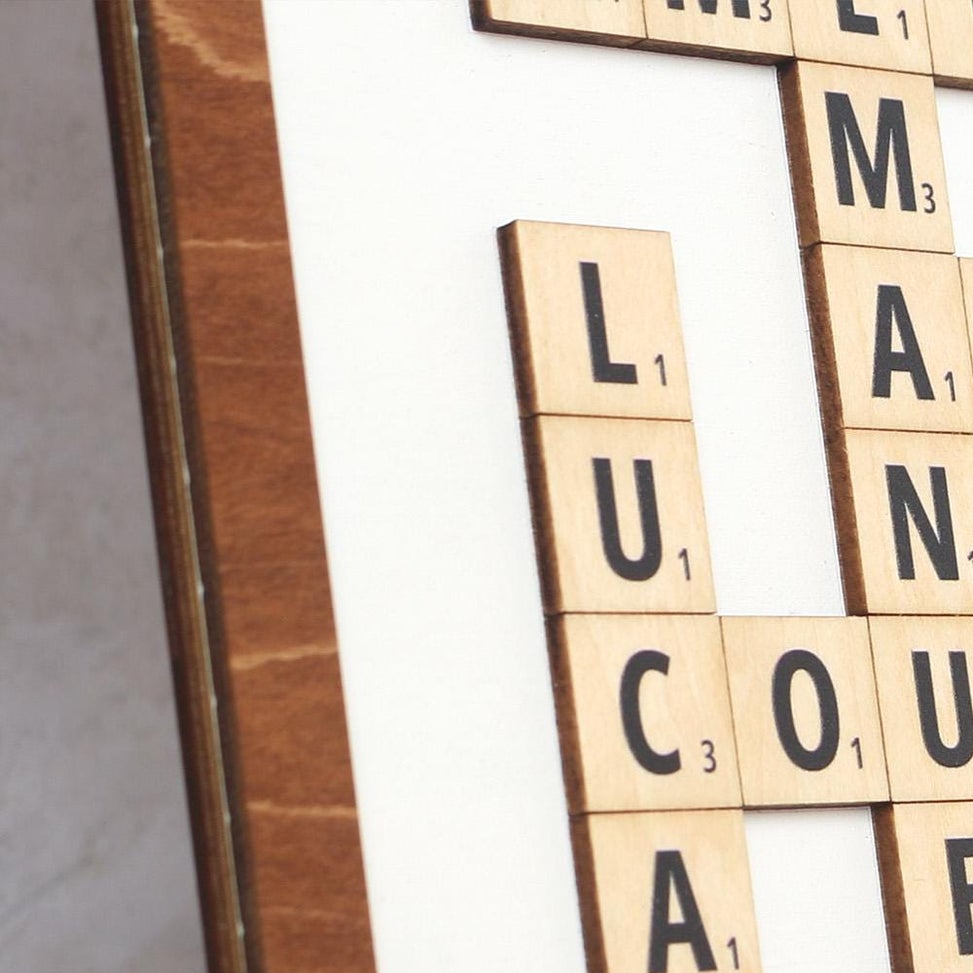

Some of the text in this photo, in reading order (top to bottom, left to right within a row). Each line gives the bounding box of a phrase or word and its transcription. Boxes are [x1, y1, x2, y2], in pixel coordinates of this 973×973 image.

[896, 9, 909, 40] 1
[921, 182, 936, 214] 3
[654, 353, 667, 387] 1
[944, 371, 956, 402] 1
[678, 547, 691, 582] 1
[701, 739, 717, 774] 3
[850, 737, 864, 770] 1
[726, 936, 740, 971] 1
